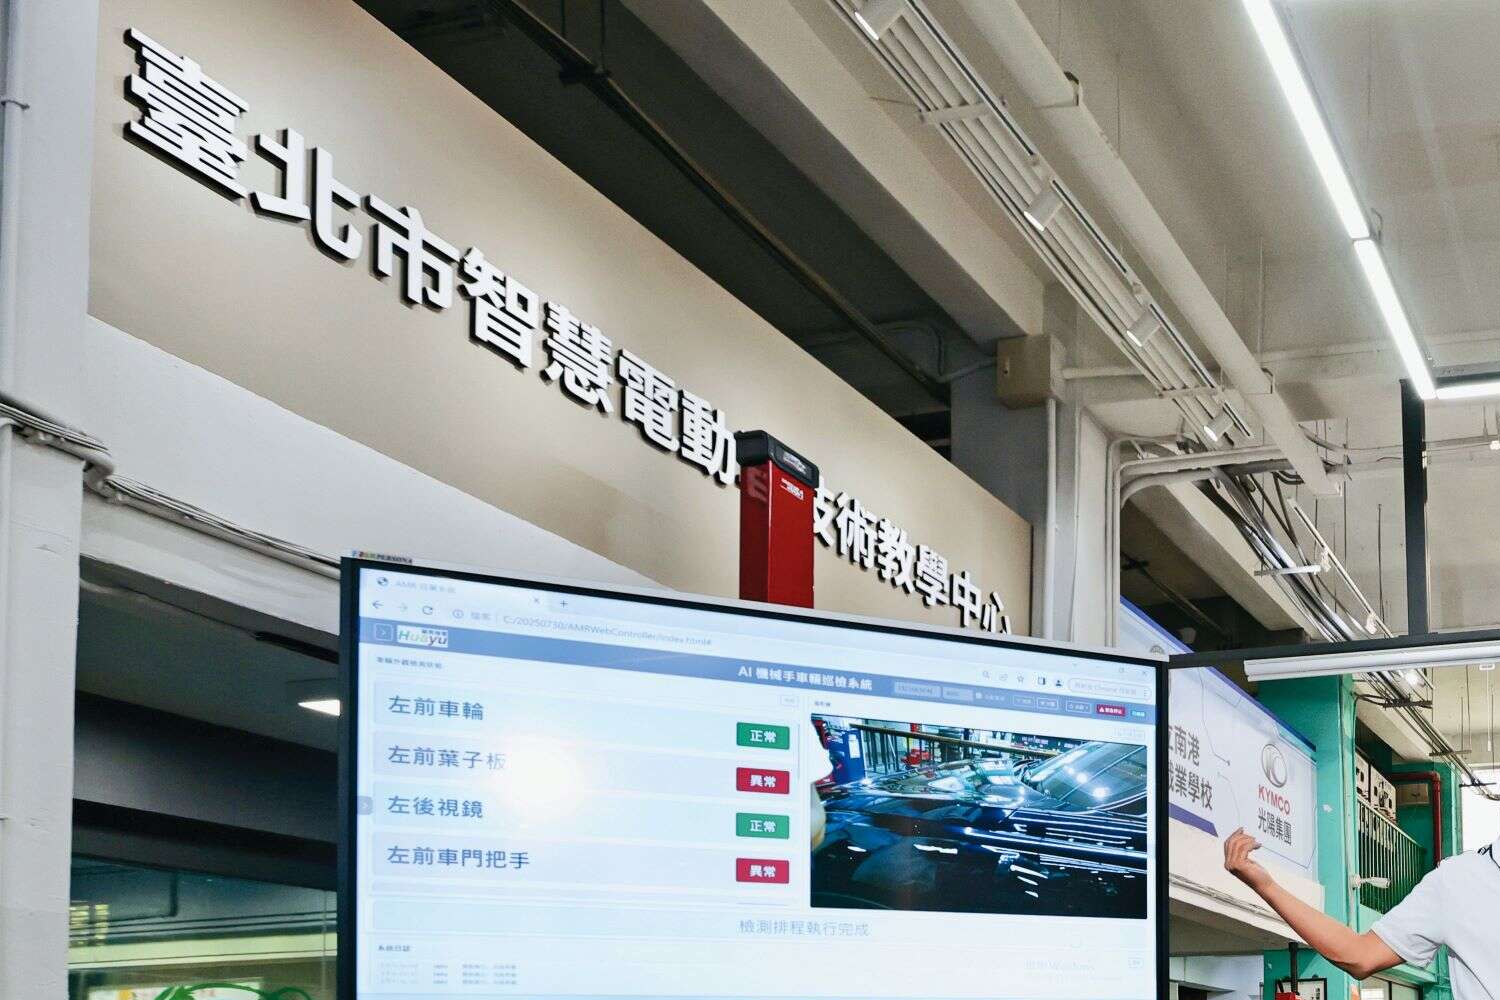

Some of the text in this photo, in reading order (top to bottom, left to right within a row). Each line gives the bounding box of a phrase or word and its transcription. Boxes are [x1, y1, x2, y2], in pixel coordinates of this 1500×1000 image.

[124, 28, 1012, 636] 臺北市智慧電動技術教學中心
[738, 666, 752, 677] AI
[388, 695, 484, 720] 左前車輪
[750, 729, 777, 743] 正常
[388, 745, 506, 770] 左前葉子板
[750, 774, 777, 788] 異常
[388, 795, 484, 818] 左後視鏡
[1258, 783, 1291, 816] KYMCO
[750, 818, 777, 833] 正常
[1257, 807, 1292, 847] 光陽集團
[387, 845, 530, 869] 左前車門把手
[750, 864, 777, 878] 異常
